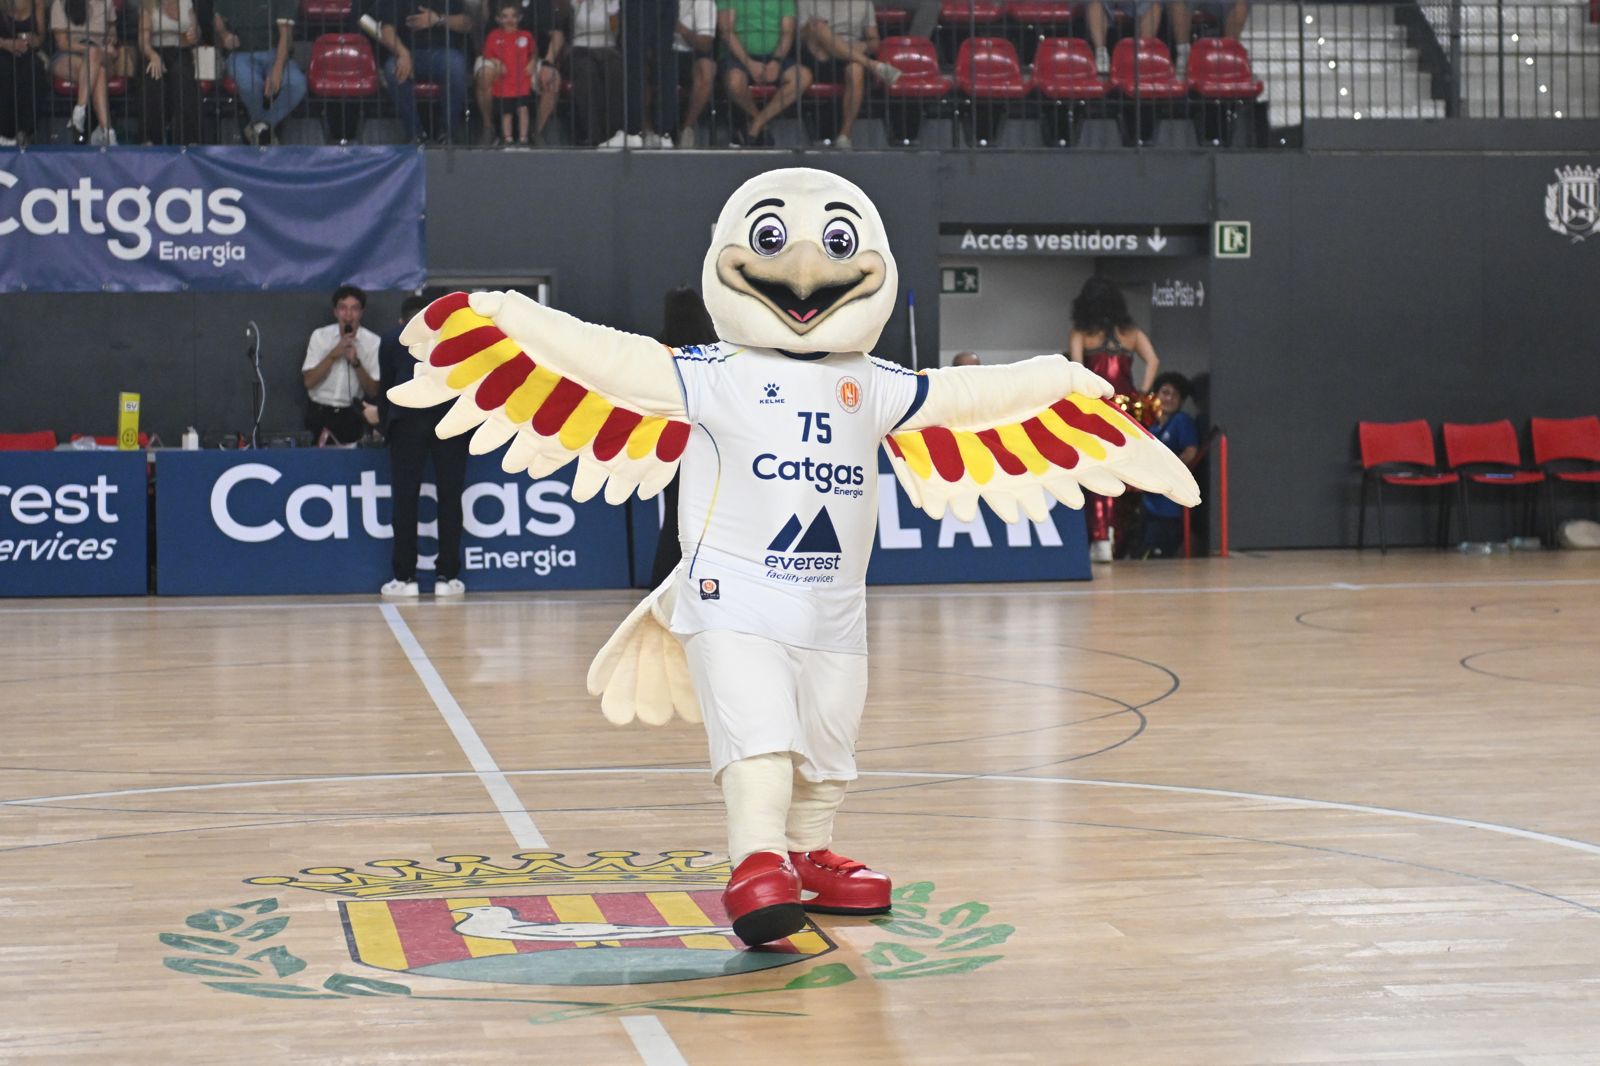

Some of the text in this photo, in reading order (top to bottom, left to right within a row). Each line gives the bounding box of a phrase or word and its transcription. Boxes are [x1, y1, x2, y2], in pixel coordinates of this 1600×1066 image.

[961, 229, 1139, 250] Accés vestidors
[797, 411, 832, 444] 75
[752, 453, 864, 493] Catgas
[465, 544, 577, 576] Energia
[764, 554, 841, 571] everest
[766, 569, 834, 583] facility services
